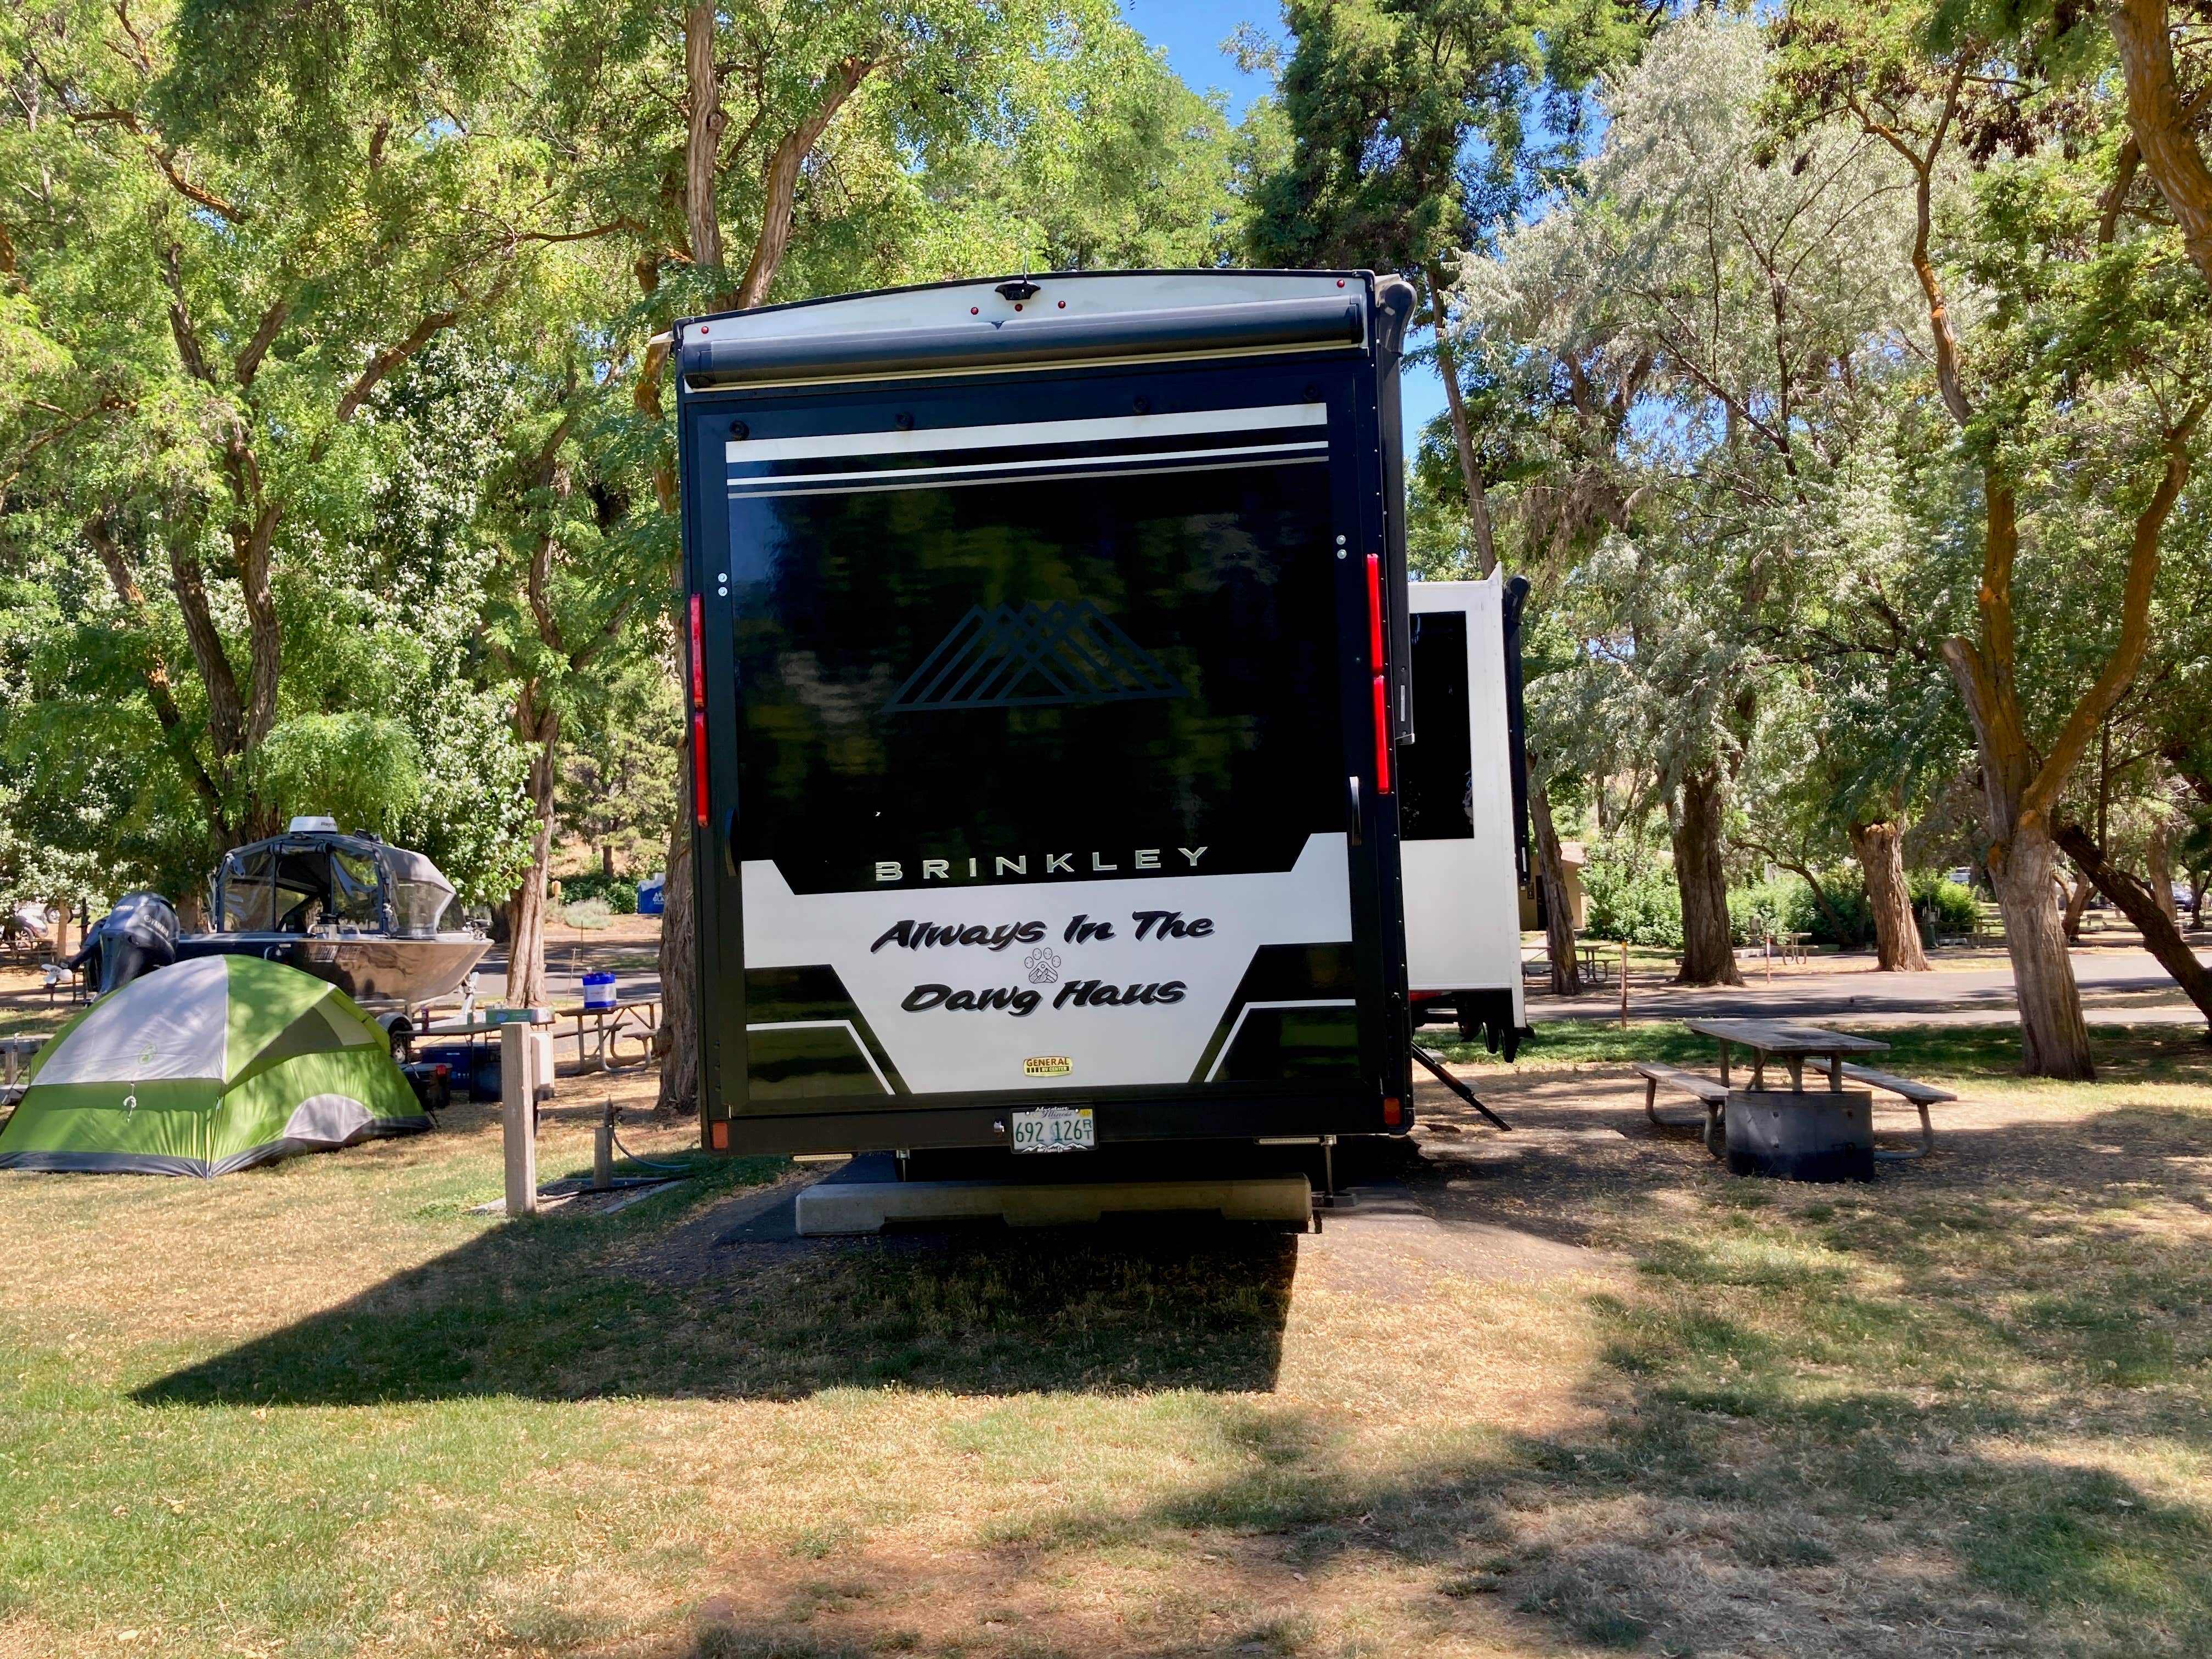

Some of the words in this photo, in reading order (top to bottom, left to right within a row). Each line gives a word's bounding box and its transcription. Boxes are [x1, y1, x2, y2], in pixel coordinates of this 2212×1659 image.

[875, 847, 1207, 881] BRINKLEY
[151, 918, 170, 938] YAMAHA
[870, 919, 1047, 953] Always
[1063, 914, 1115, 945] In
[1132, 910, 1215, 942] The
[900, 984, 1043, 1017] Dawg
[1053, 979, 1186, 1010] Haus
[1026, 1057, 1069, 1066] GENERAL
[1015, 1122, 1044, 1142] 692
[1054, 1119, 1082, 1141] 126
